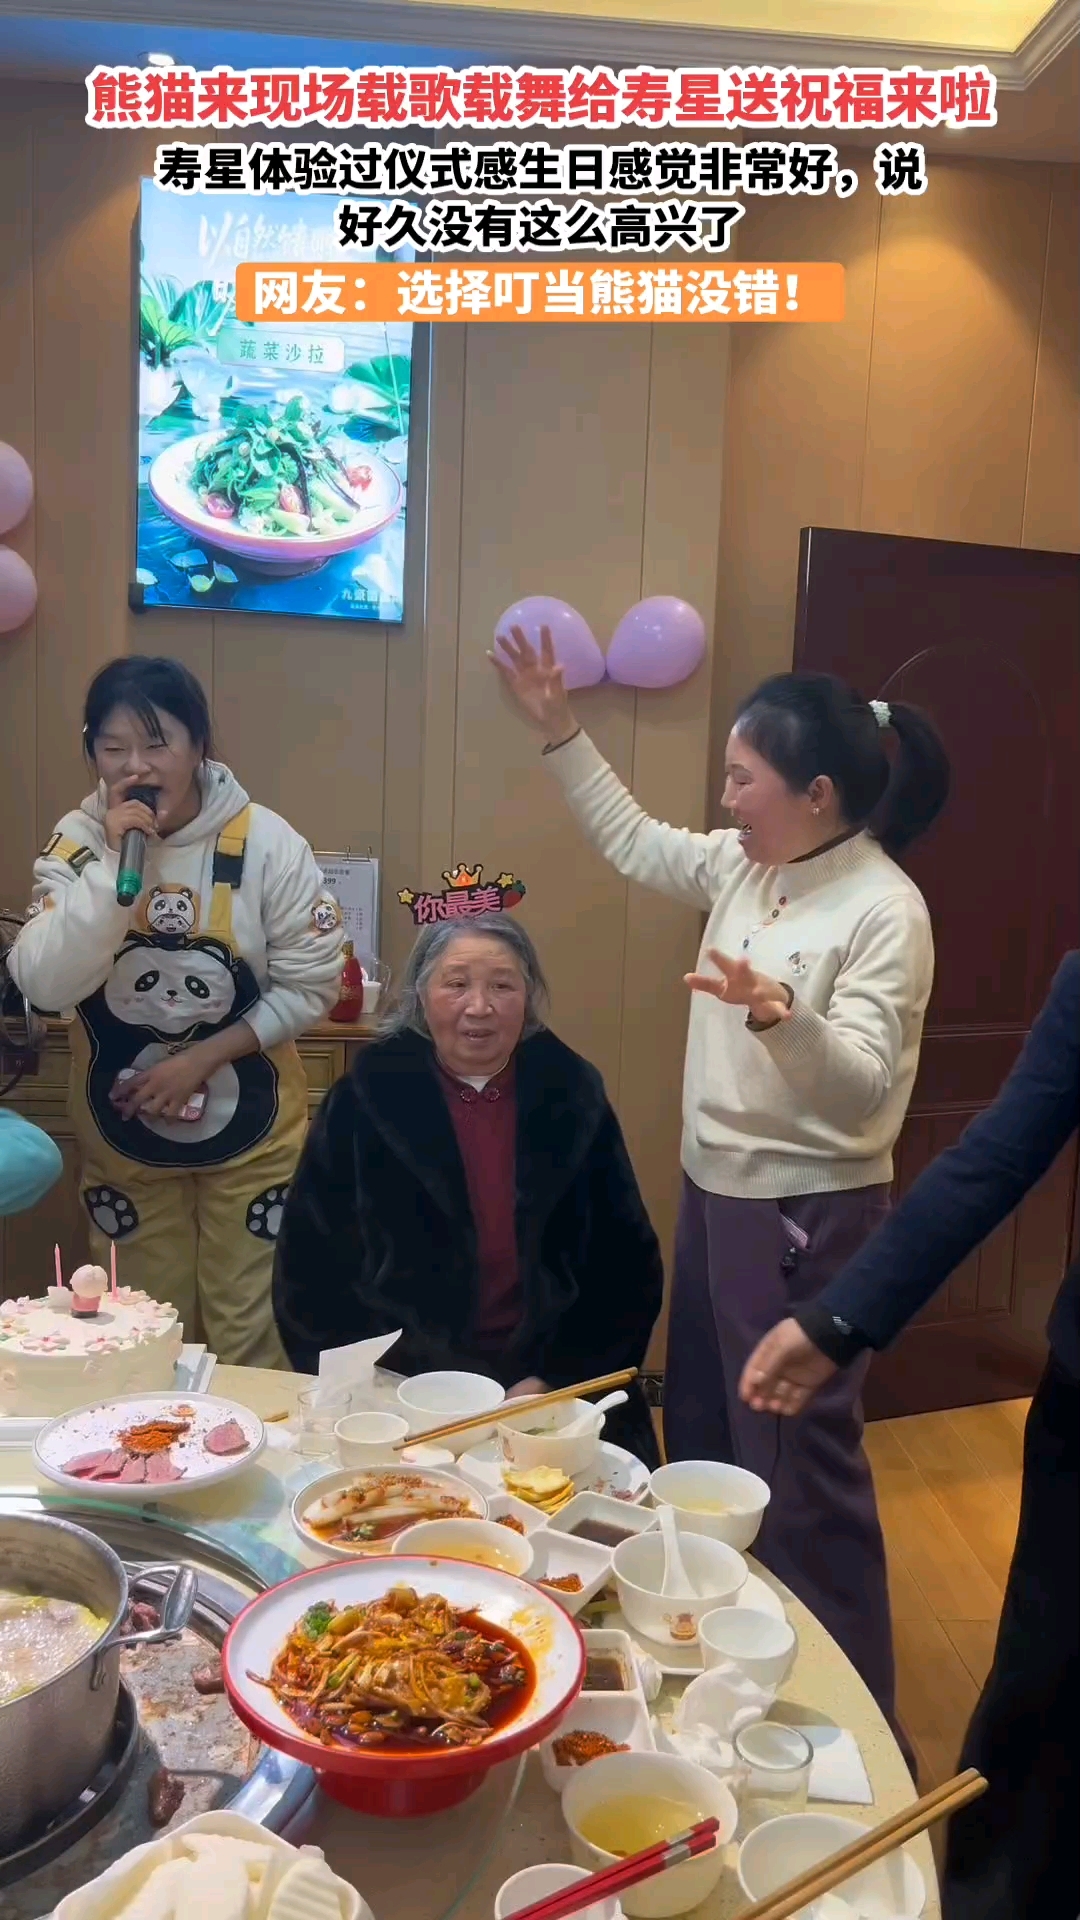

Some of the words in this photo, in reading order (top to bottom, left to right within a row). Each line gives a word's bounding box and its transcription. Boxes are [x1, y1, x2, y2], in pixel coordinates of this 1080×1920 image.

[240, 339, 324, 365] 蔬菜沙拉
[414, 886, 501, 922] 你最美
